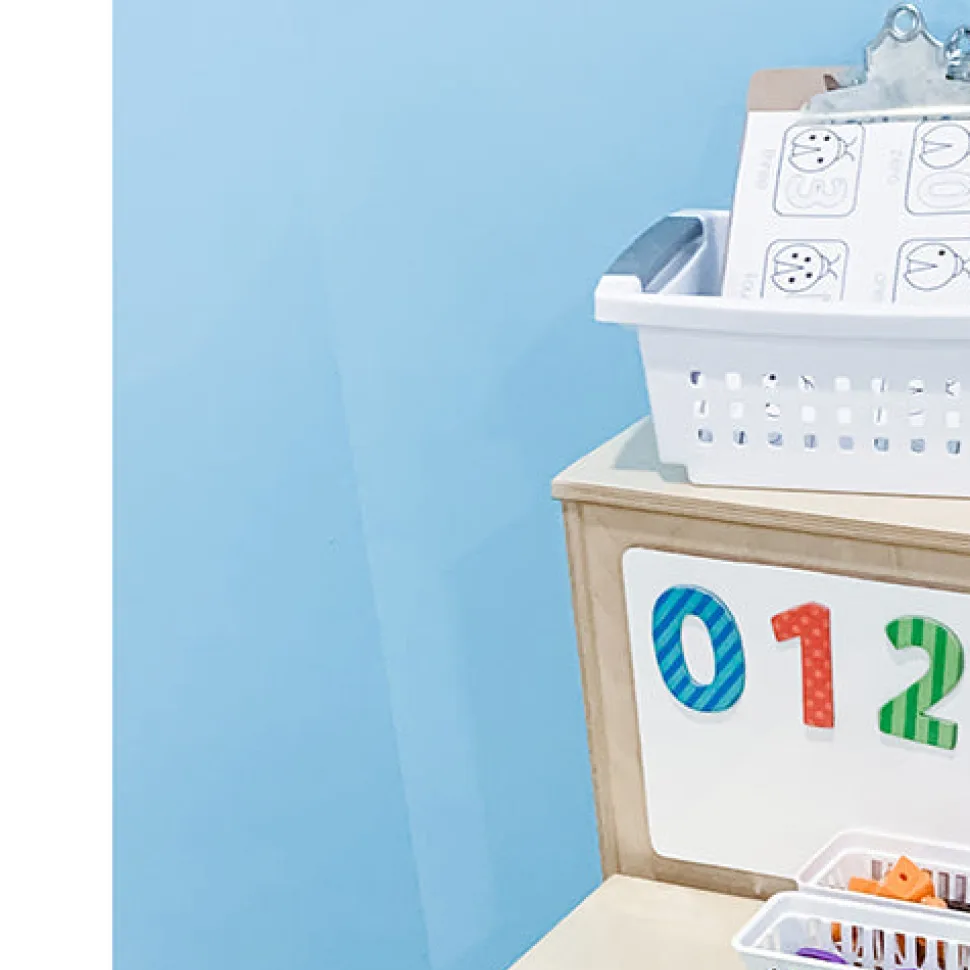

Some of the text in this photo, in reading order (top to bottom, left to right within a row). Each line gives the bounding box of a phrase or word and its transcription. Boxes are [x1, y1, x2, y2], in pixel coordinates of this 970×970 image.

[651, 583, 747, 714] 0
[769, 602, 836, 730] 1
[876, 616, 965, 751] 2
